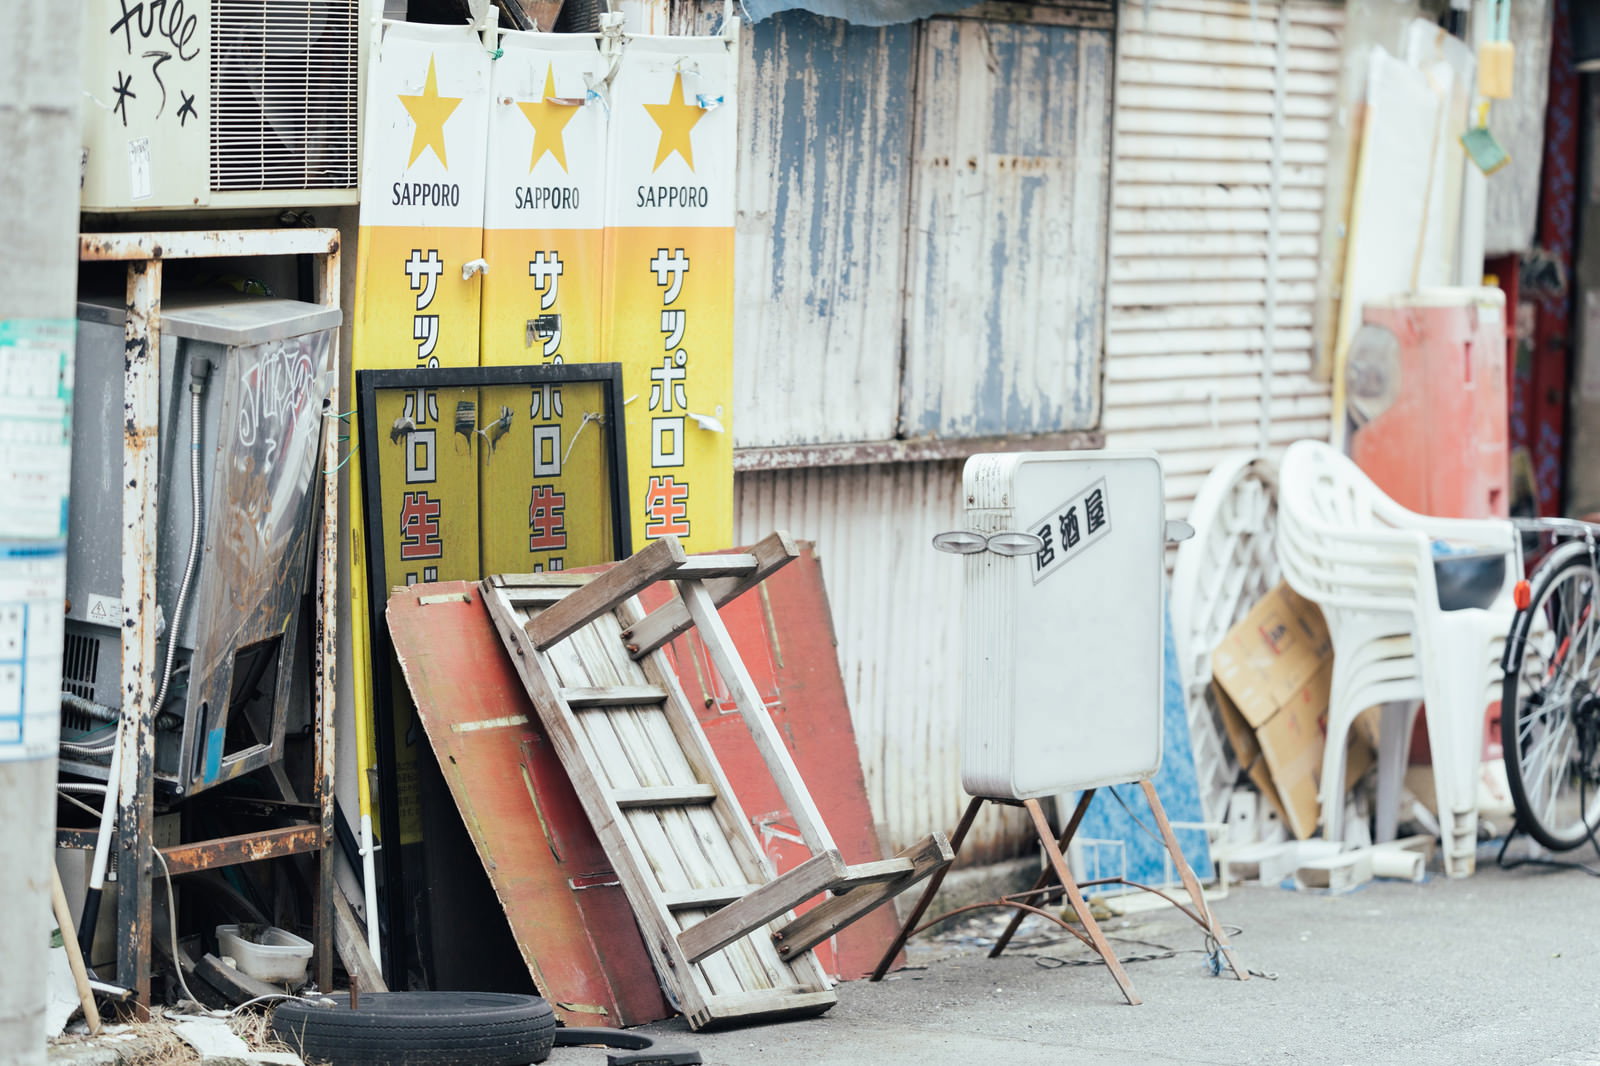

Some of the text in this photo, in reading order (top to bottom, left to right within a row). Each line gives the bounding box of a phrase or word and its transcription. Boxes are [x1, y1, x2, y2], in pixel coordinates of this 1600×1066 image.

[392, 181, 460, 208] SAPPORO
[514, 185, 580, 210] SAPPORO
[636, 184, 708, 208] SAPPORO
[1036, 488, 1106, 571] 居酒屋
